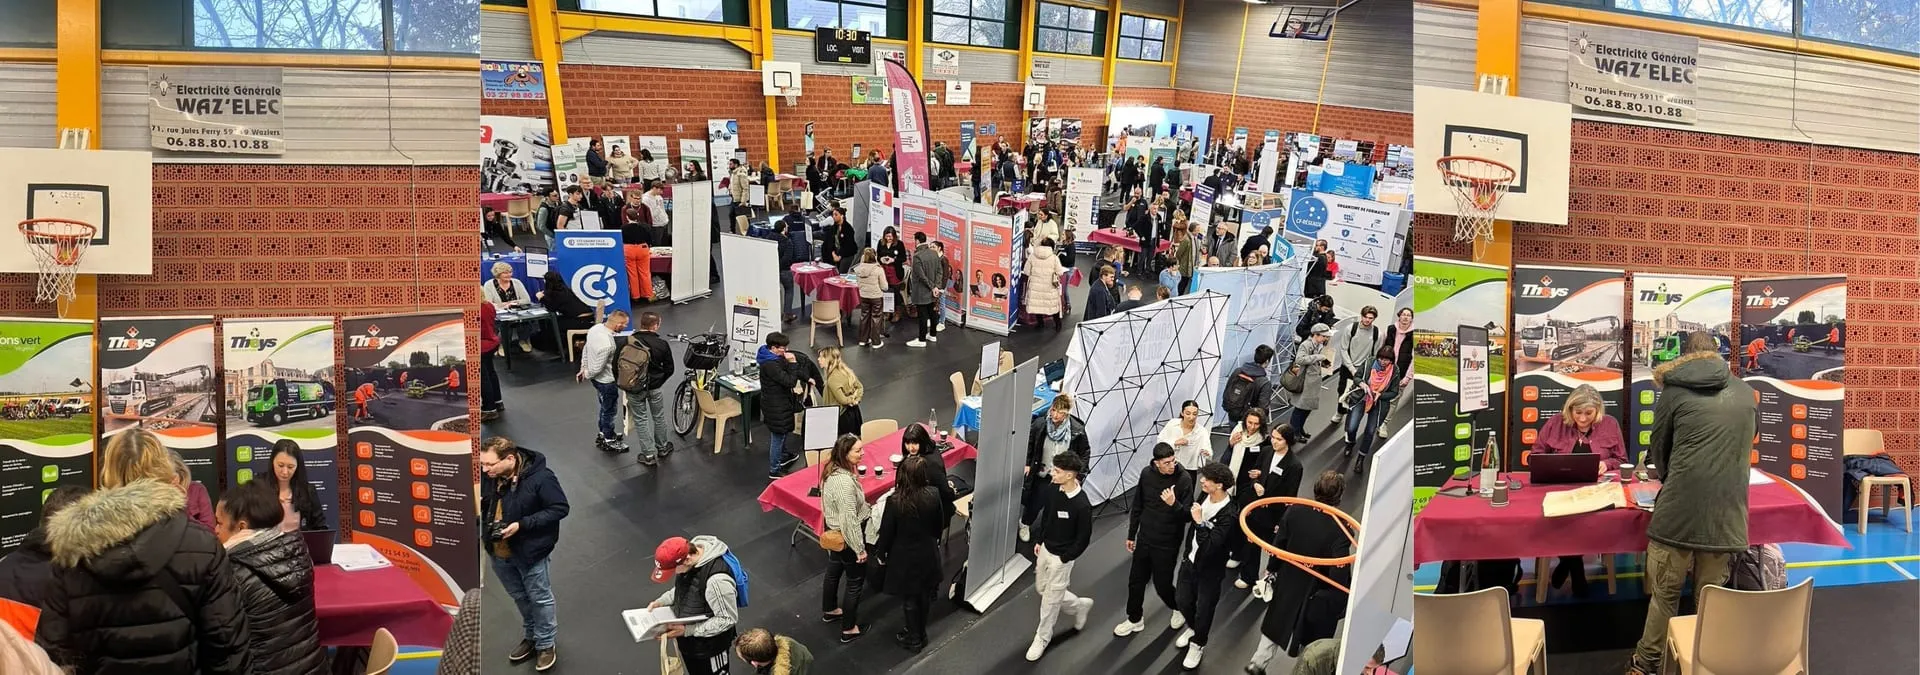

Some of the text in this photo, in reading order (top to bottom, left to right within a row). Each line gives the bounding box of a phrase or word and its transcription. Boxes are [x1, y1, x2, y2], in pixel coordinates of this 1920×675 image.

[835, 29, 857, 41] 10:30
[1596, 44, 1697, 66] Electricité Générale
[1594, 57, 1694, 84] WAZ'ELEC
[176, 85, 281, 96] Electricité Générale
[1599, 87, 1617, 96] Jules
[1619, 90, 1637, 100] Ferry
[175, 98, 280, 115] WAZ'ELEC
[1584, 95, 1682, 117] 06.88.80.10.88
[201, 128, 221, 136] Ferry
[166, 137, 269, 150] 06.88.80.10.88
[1521, 283, 1569, 299] Theys
[1640, 290, 1683, 305] Theys
[1746, 295, 1790, 308] Theys
[735, 327, 755, 336] SMTD
[107, 336, 157, 350] Theys
[230, 335, 278, 351] Theys
[349, 334, 400, 350] Theys
[1463, 357, 1486, 371] Theys
